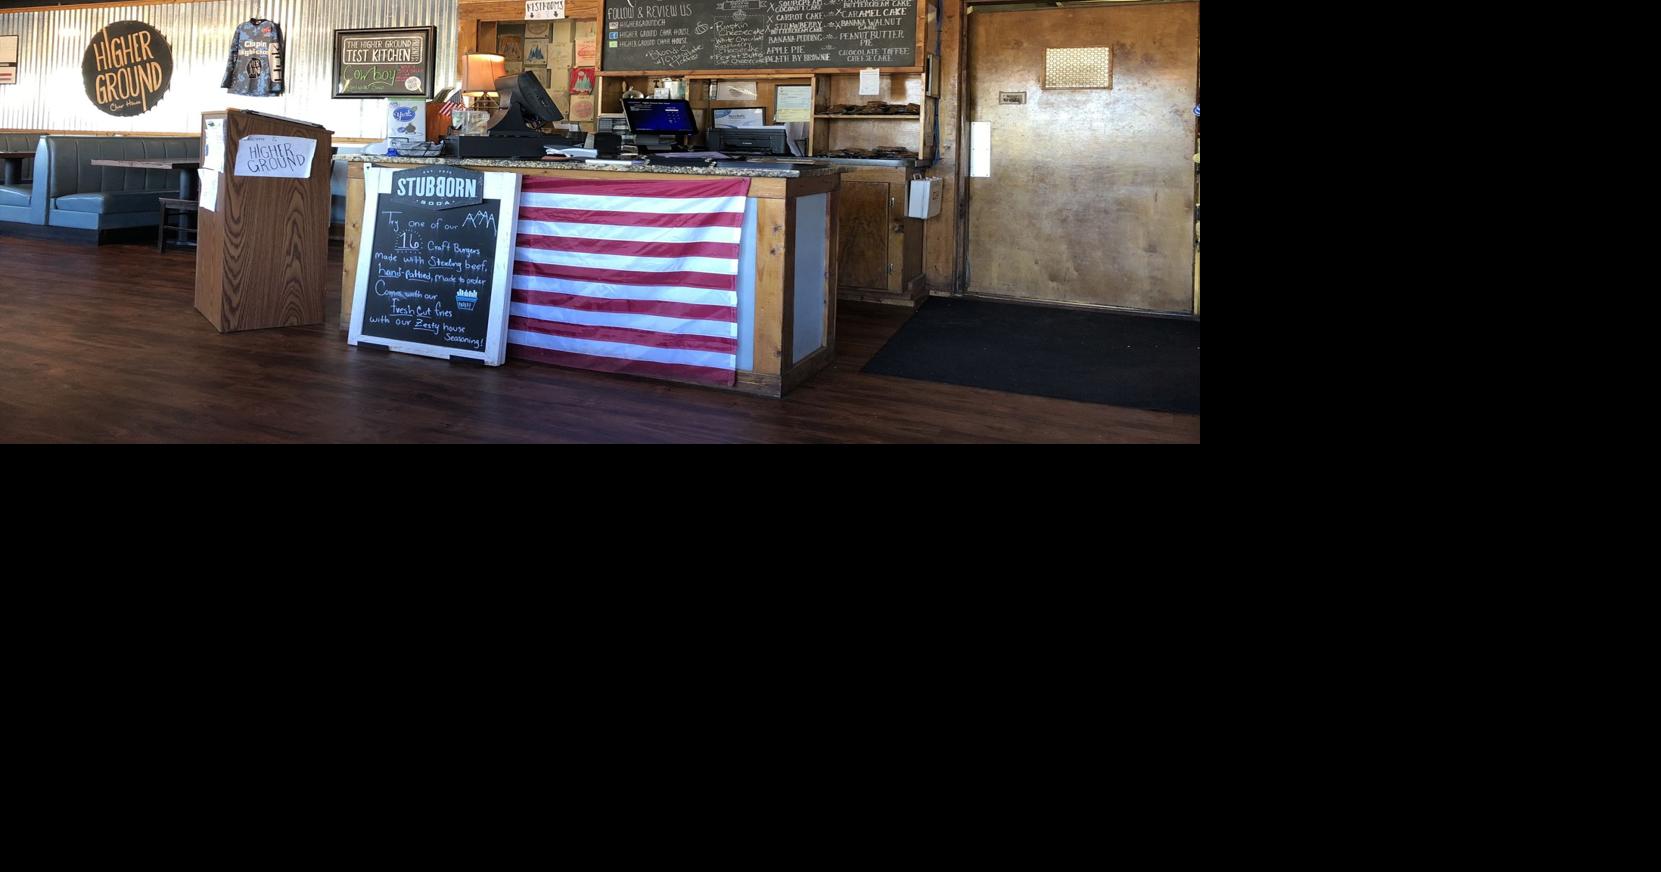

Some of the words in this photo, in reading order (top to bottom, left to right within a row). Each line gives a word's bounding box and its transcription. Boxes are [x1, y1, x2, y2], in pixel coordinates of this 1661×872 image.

[527, 1, 563, 11] RESTROOMS
[608, 7, 634, 20] FOLLOW
[637, 7, 643, 19] &
[646, 5, 677, 18] REVIEW
[680, 3, 692, 16] US
[776, 13, 803, 21] CARROT
[805, 12, 823, 20] CAKE
[840, 19, 866, 27] BANANA
[867, 17, 902, 26] WALNUT
[775, 21, 822, 30] STRAWBERRY
[768, 36, 795, 44] BANANA
[840, 32, 868, 40] PEANUT
[870, 30, 904, 39] BUTTER
[94, 27, 153, 71] HIGHER
[347, 41, 358, 49] THE
[360, 40, 383, 49] HIGHER
[384, 39, 411, 48] GROUND
[766, 46, 790, 55] APPLE
[791, 45, 804, 54] PIE
[346, 49, 368, 62] TEST
[372, 48, 411, 62] KITCHEN
[882, 47, 910, 55] TOFFEE
[792, 54, 803, 62] BY
[343, 64, 396, 86] Cowboy
[95, 61, 163, 112] GROUND
[249, 143, 294, 160] HIGHER
[247, 154, 306, 173] GROUND
[396, 176, 477, 199] STUBBORN
[420, 199, 451, 207] SODA
[381, 211, 403, 232] Try
[408, 219, 425, 229] one
[430, 217, 443, 230] of
[444, 223, 459, 231] our
[398, 232, 420, 250] 16
[427, 241, 451, 252] Craft
[453, 242, 481, 259] Burgers
[403, 254, 425, 266] with
[458, 275, 466, 284] to
[466, 276, 487, 287] order
[390, 297, 415, 316] Fresh
[416, 305, 432, 317] Cut
[369, 314, 391, 324] with
[395, 318, 412, 327] our
[414, 317, 441, 336] Zesty
[442, 322, 466, 334] house
